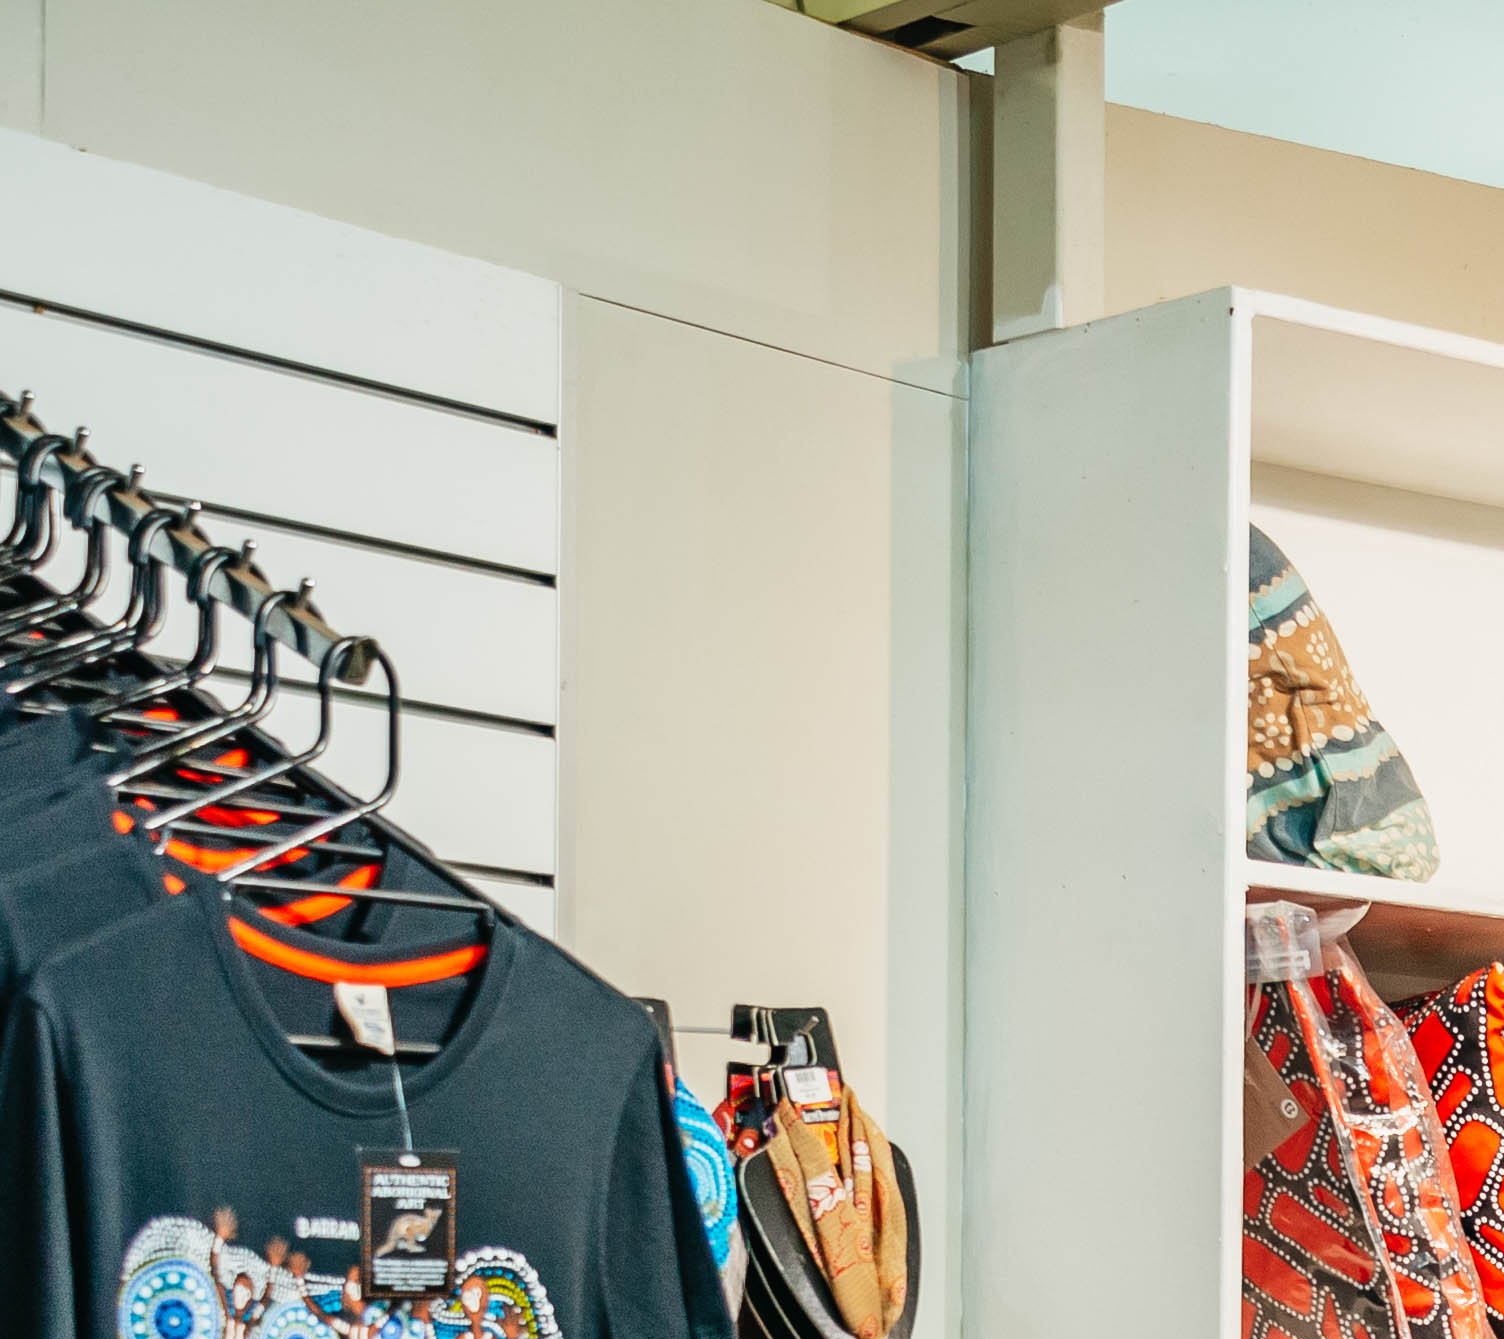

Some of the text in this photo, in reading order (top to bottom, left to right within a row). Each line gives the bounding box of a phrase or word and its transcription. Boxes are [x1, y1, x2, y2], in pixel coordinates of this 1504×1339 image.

[373, 1173, 451, 1187] AUTHENTIC
[371, 1186, 452, 1199] ABORIGINAL
[395, 1198, 427, 1210] ART
